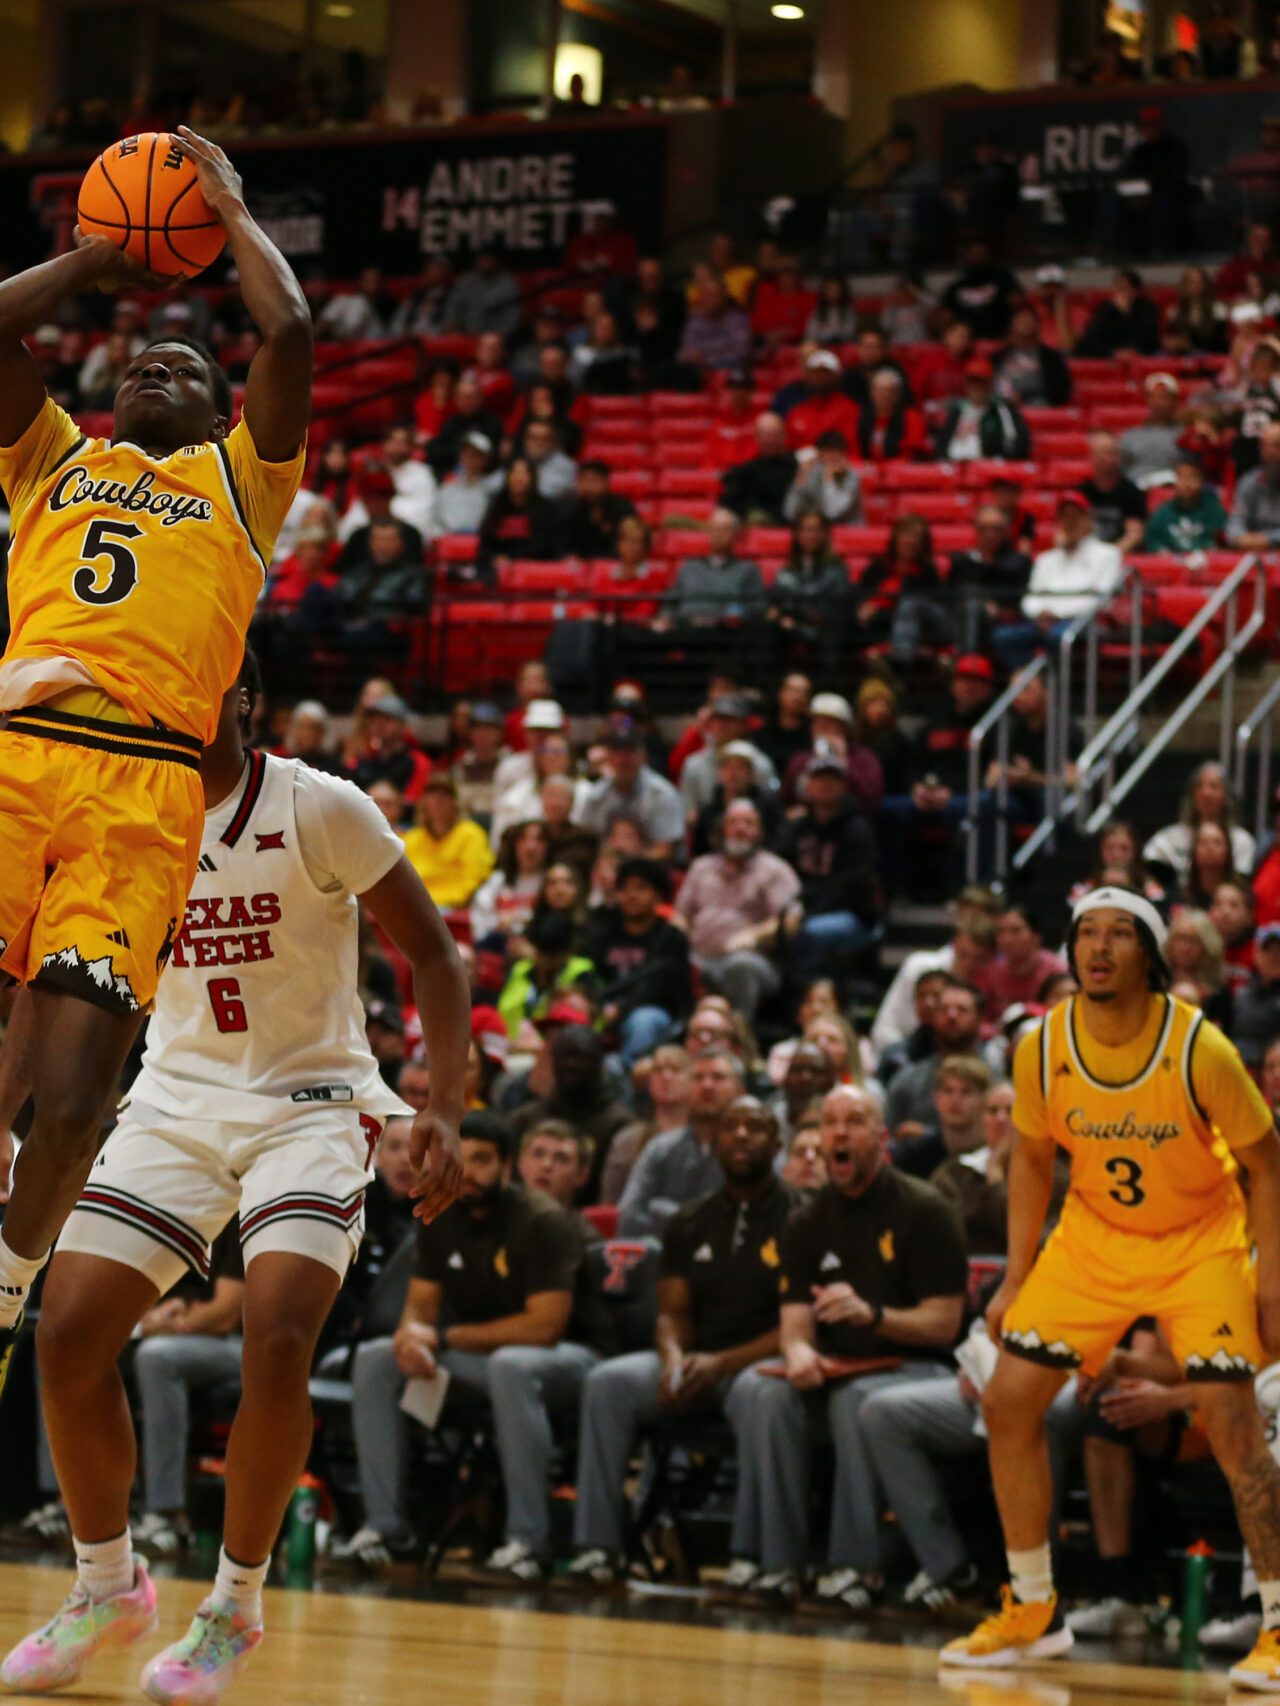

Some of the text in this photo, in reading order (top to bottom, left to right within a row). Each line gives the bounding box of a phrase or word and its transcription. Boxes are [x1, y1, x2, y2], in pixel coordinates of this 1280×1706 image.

[425, 153, 573, 203] ANDRE
[49, 465, 212, 526] Cowboys
[72, 519, 147, 606] 5
[182, 893, 282, 929] EXAS
[172, 929, 275, 968] TECH
[207, 977, 248, 1033] 6
[1064, 1107, 1182, 1149] Cowboys
[1106, 1156, 1145, 1207] 3
